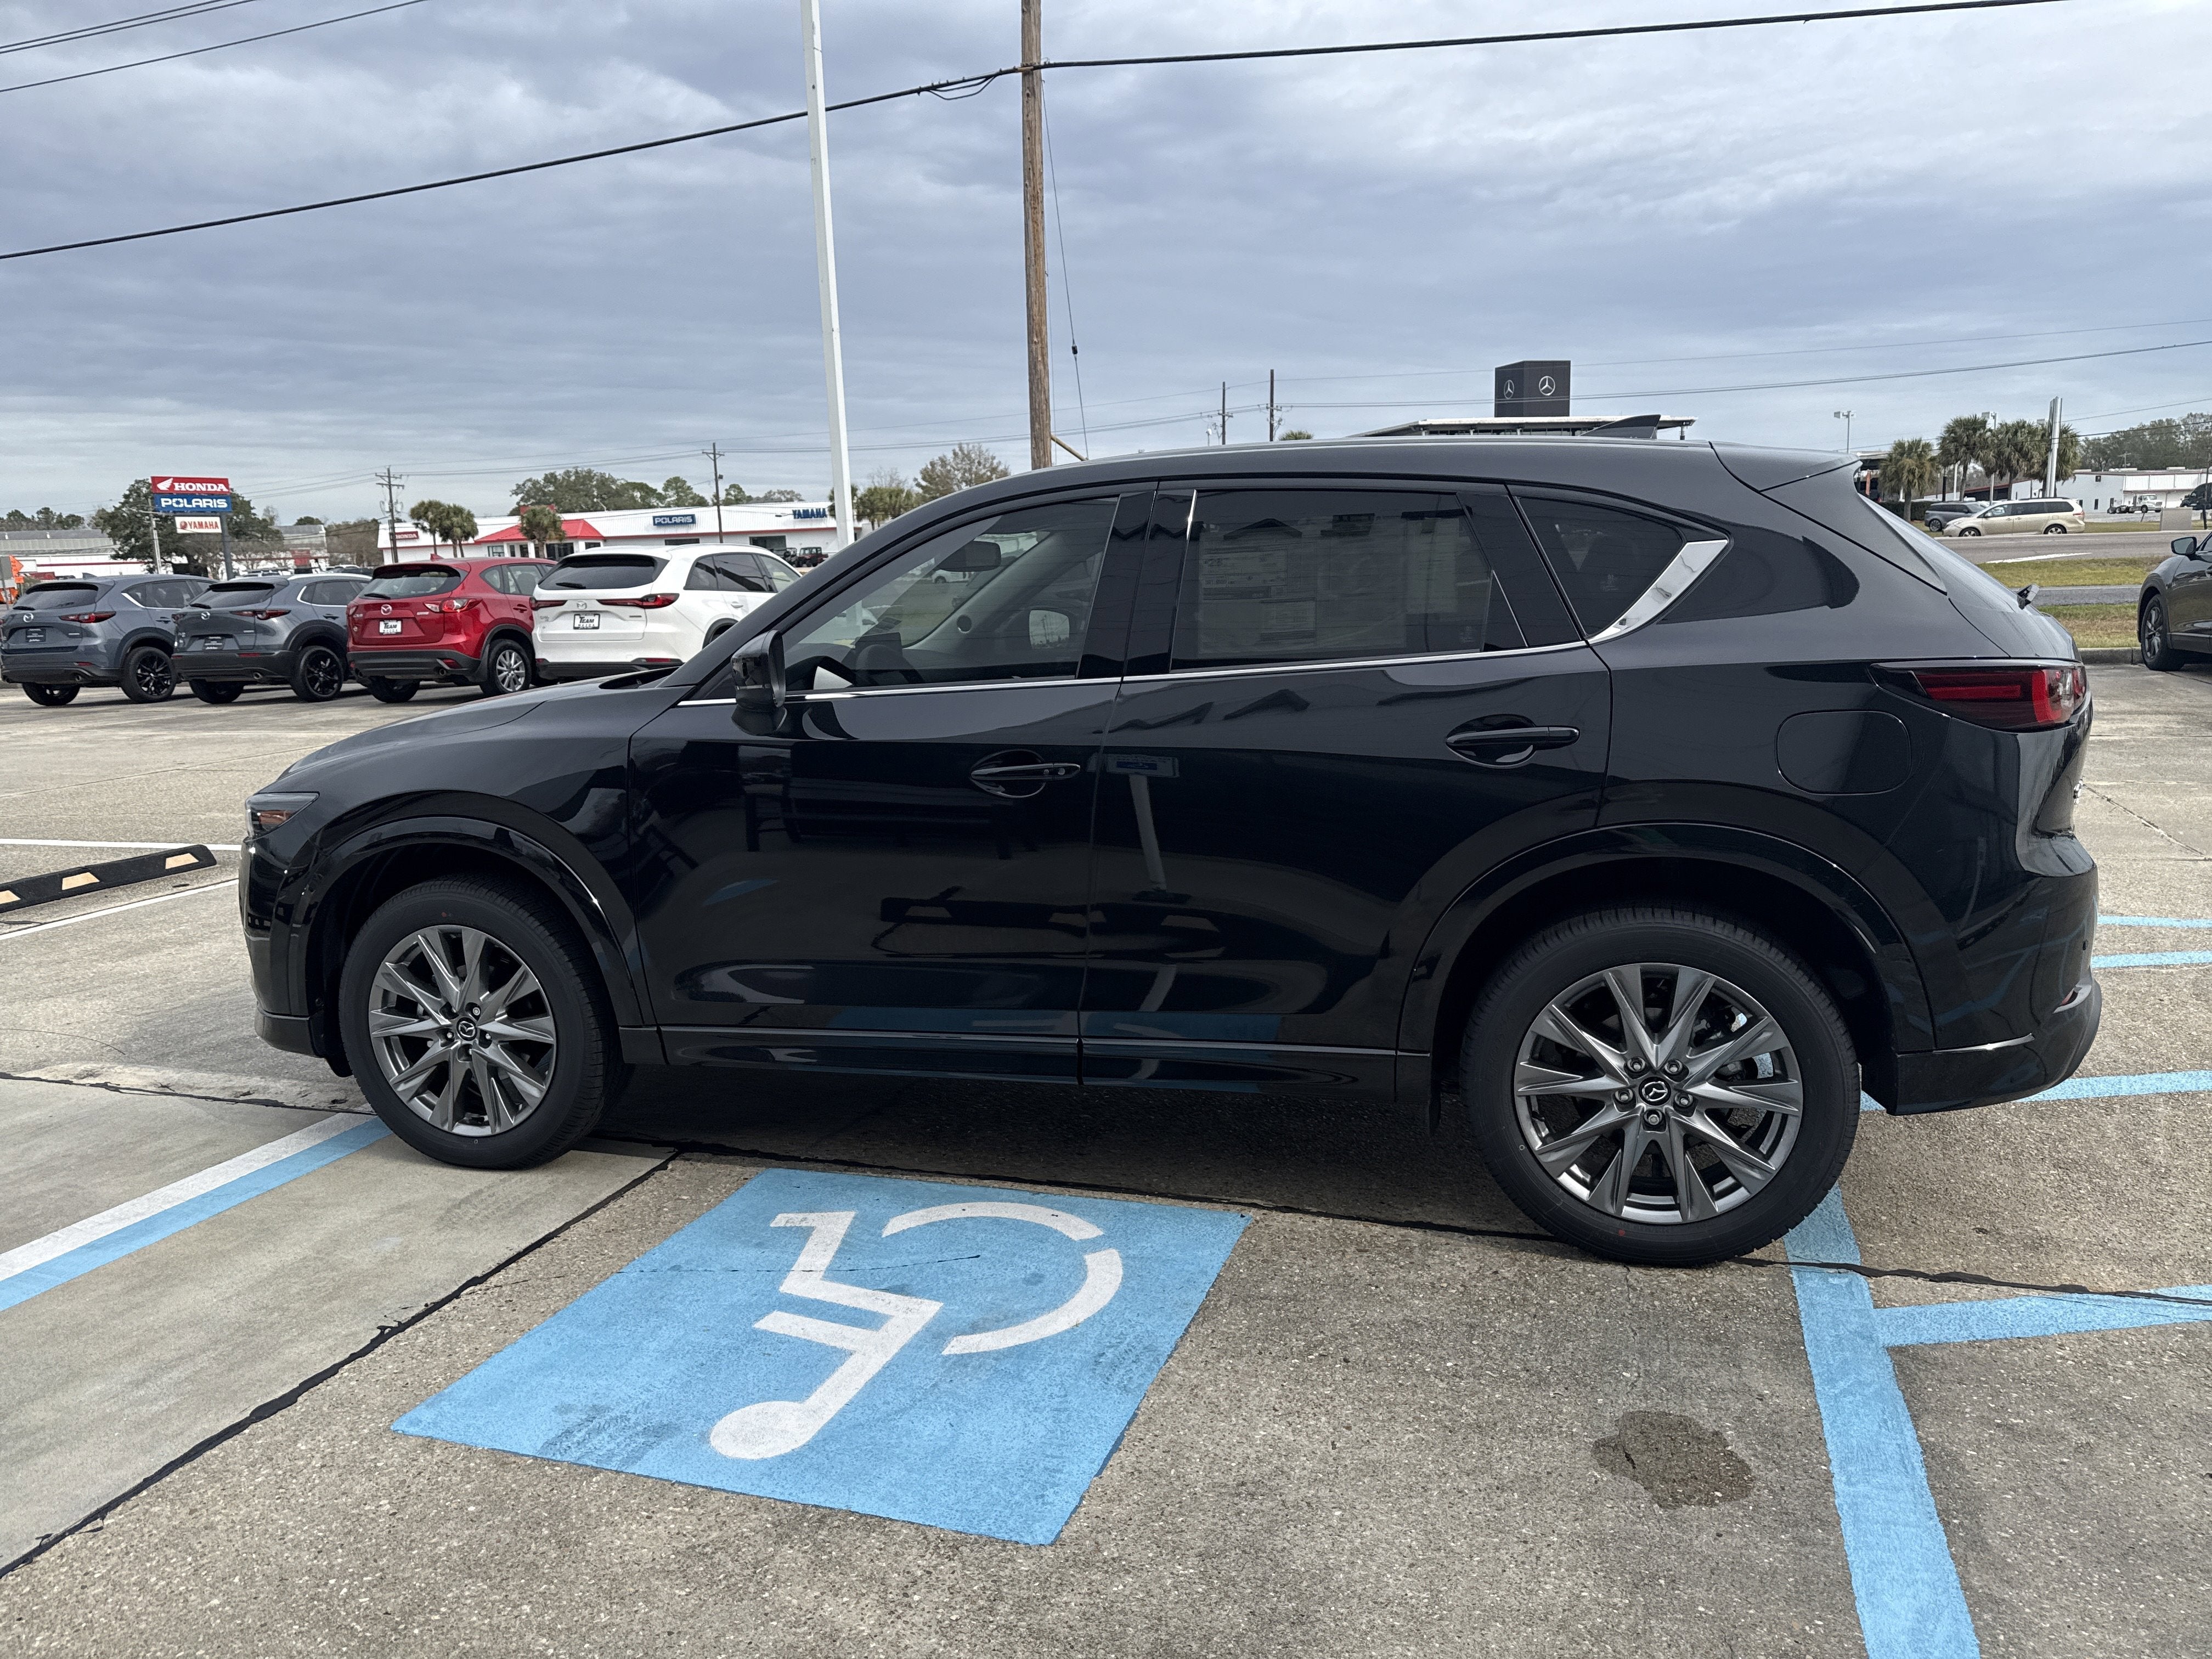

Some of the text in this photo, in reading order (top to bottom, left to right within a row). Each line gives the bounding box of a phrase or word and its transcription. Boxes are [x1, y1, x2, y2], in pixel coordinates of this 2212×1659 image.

[173, 482, 229, 492] HONDA
[160, 498, 228, 508] POLARIS
[792, 508, 827, 519] YAMAHA
[187, 521, 219, 529] YAMAHA
[654, 516, 693, 524] POLARIS
